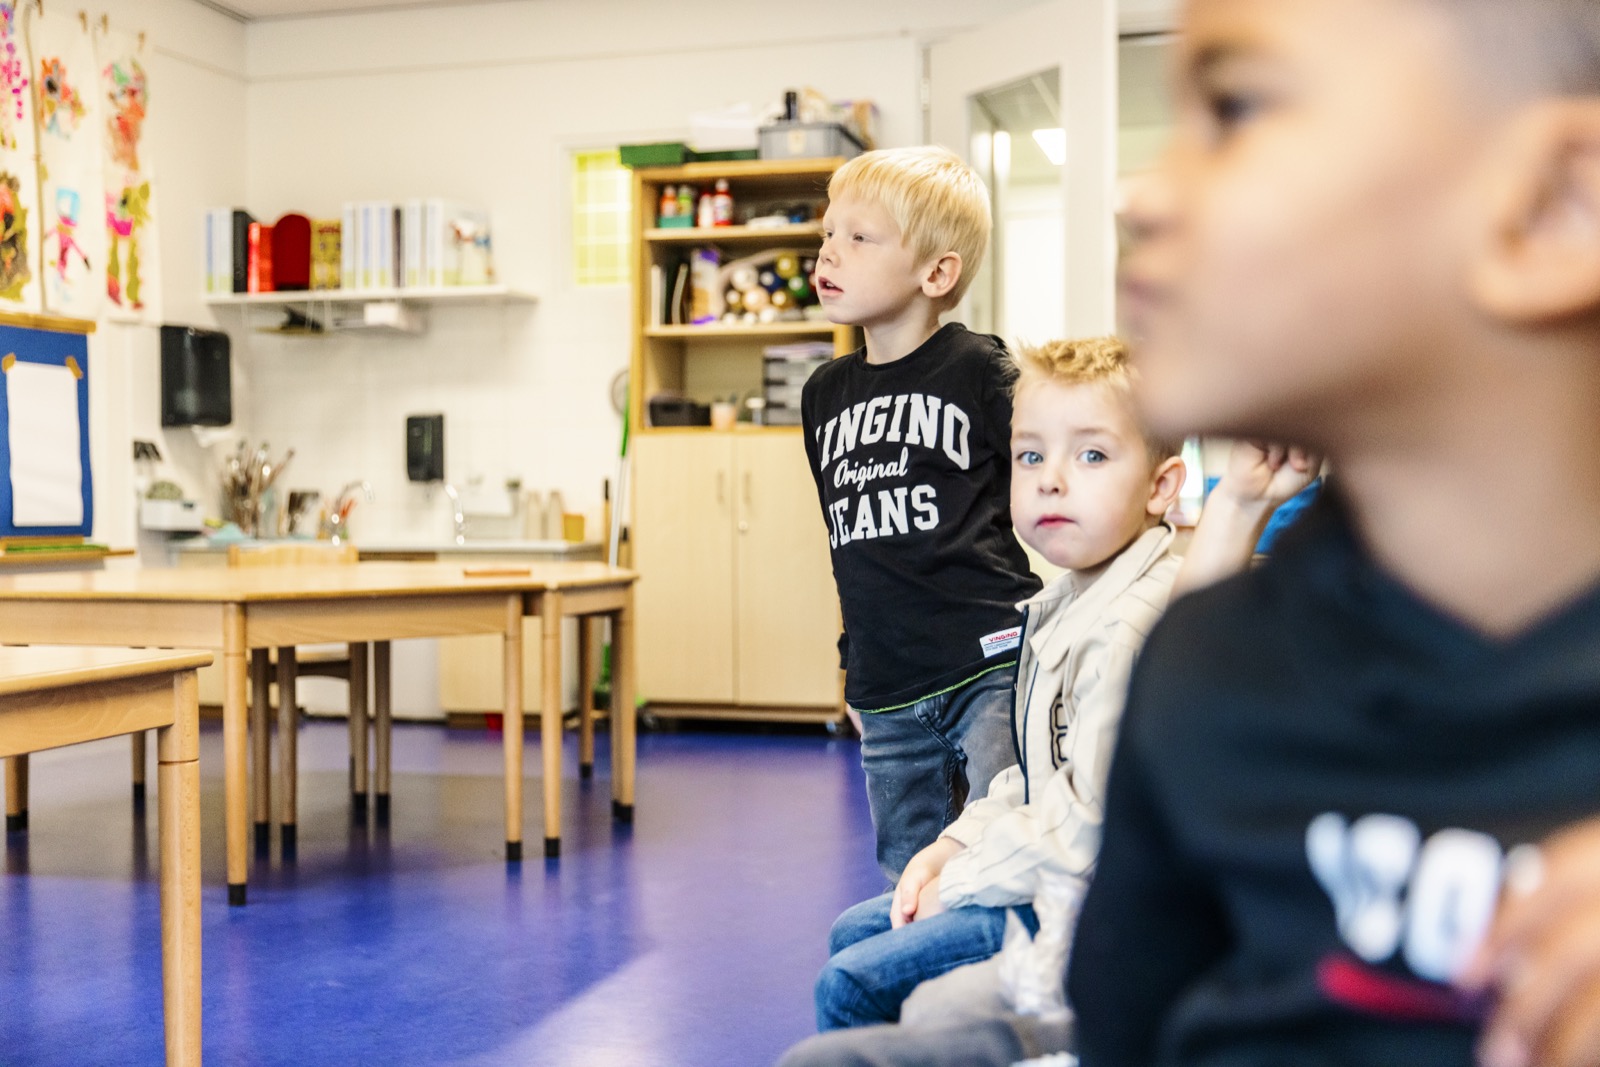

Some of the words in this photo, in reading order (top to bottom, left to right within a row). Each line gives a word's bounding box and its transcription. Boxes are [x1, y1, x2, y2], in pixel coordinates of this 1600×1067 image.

[833, 446, 909, 492] Original
[828, 484, 940, 550] JEANS
[988, 631, 1018, 642] VINGINO
